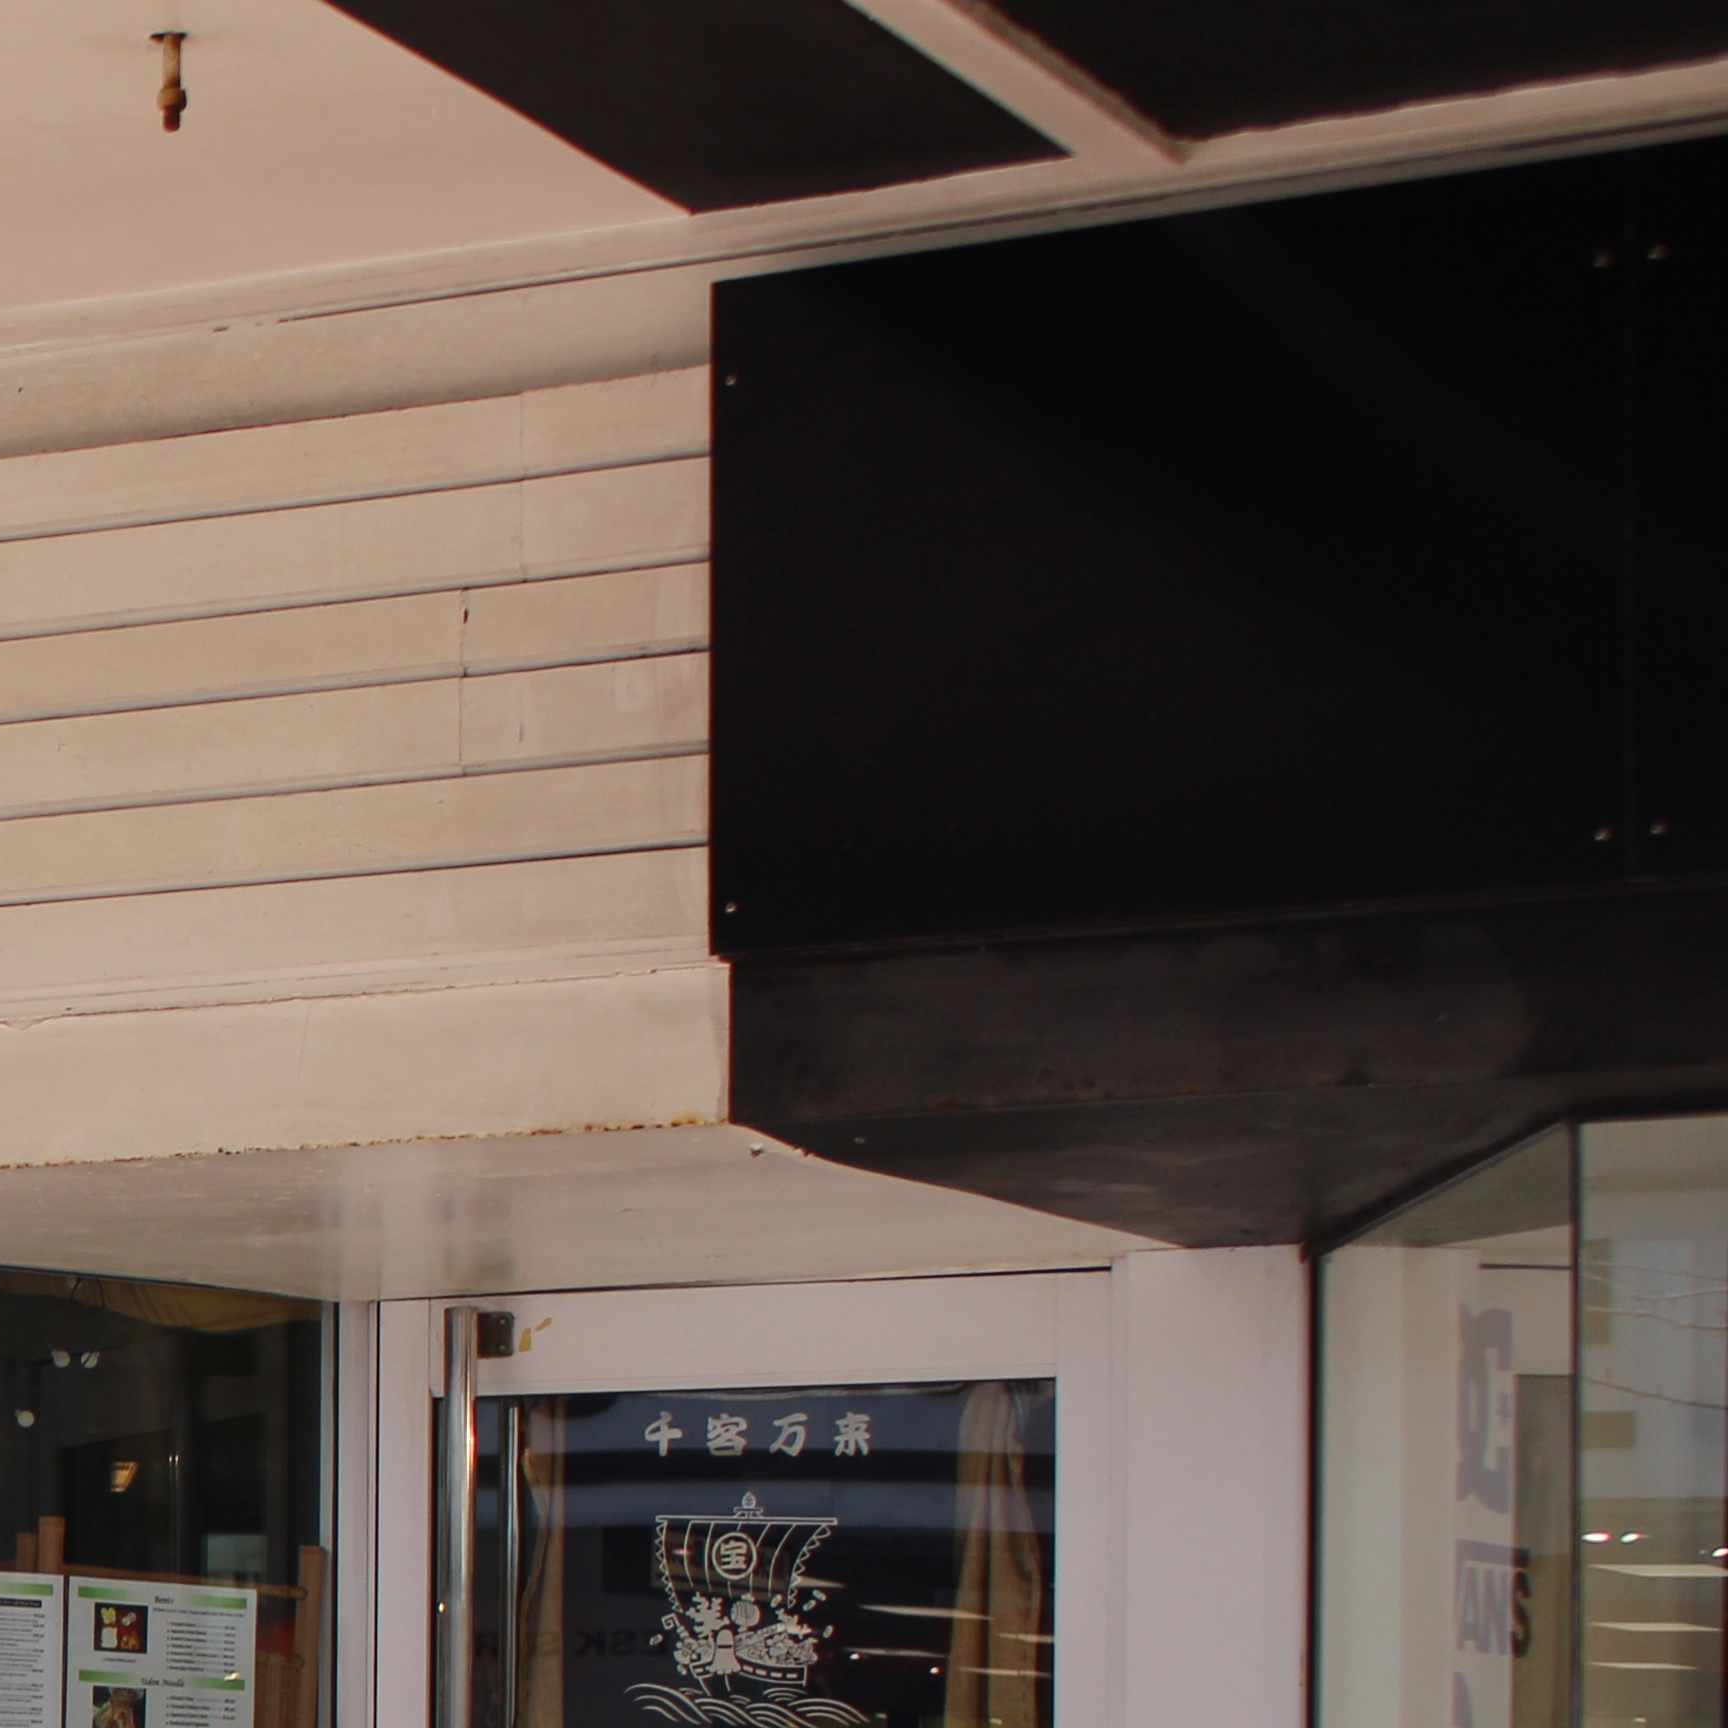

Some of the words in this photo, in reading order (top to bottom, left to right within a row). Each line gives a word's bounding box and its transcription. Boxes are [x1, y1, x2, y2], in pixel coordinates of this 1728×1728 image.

[645, 1410, 871, 1459] 千客万来
[719, 1539, 749, 1571] 宝
